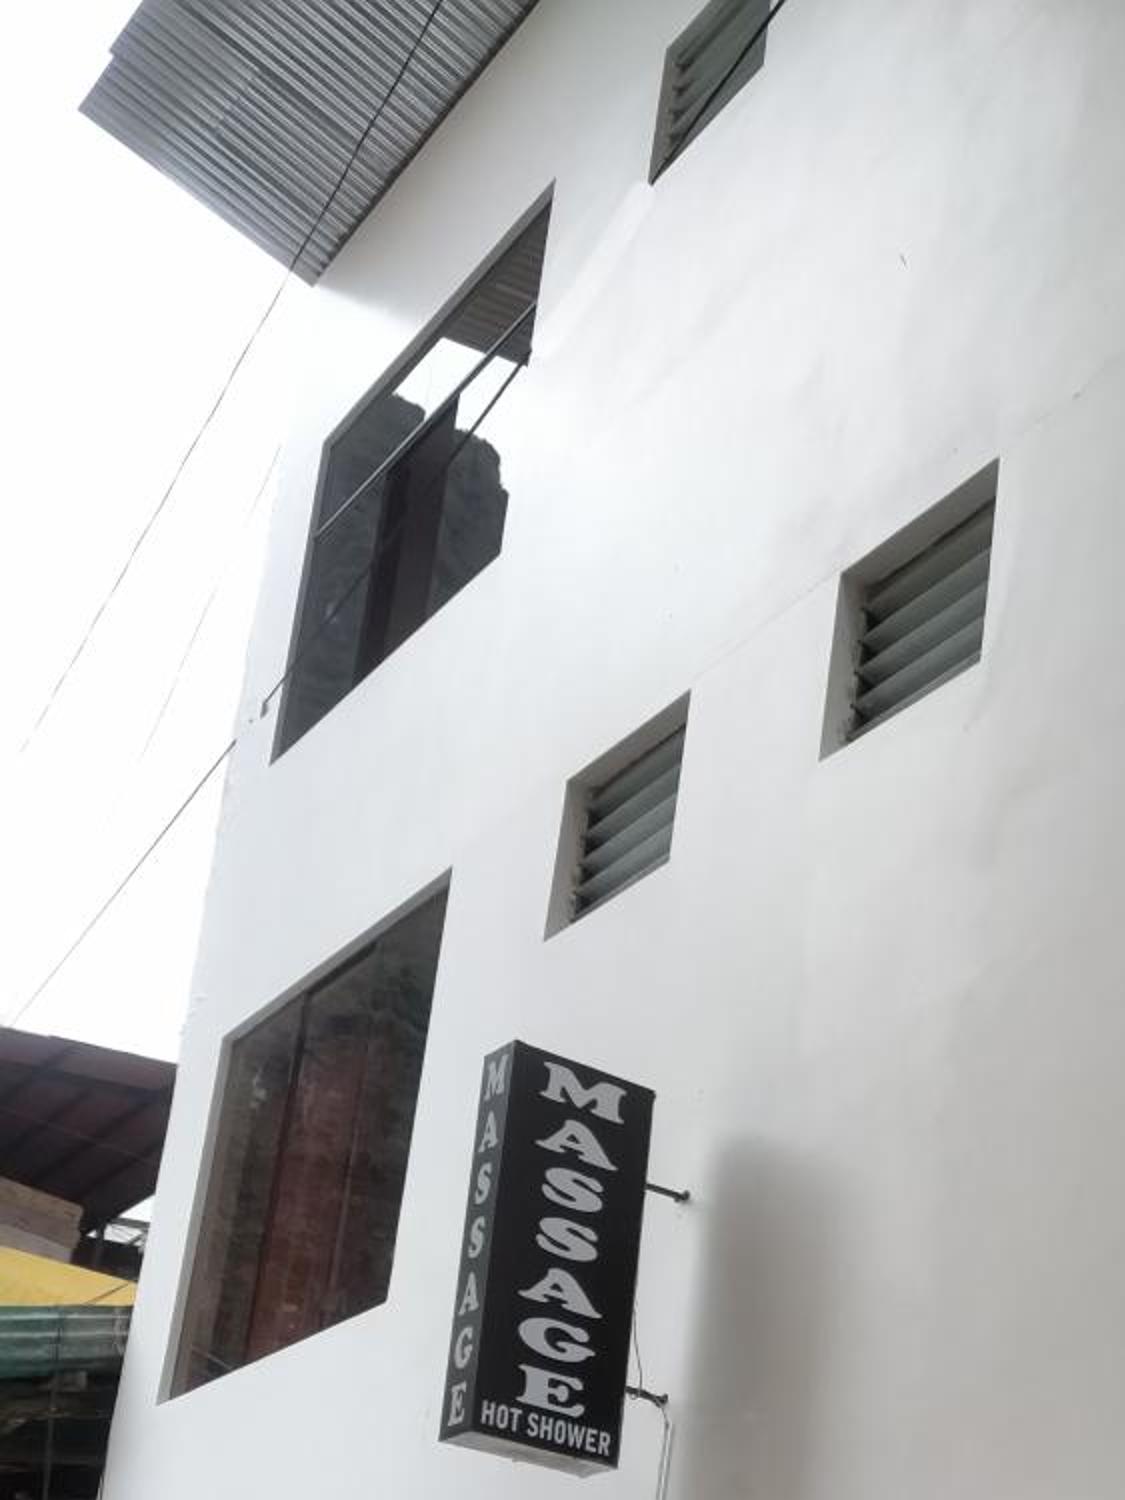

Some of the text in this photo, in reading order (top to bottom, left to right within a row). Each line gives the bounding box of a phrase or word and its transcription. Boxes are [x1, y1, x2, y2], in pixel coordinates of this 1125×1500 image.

[447, 1054, 507, 1428] MASSAGE
[517, 1061, 627, 1418] MASSAGE
[480, 1399, 612, 1457] HOT SHOWER
